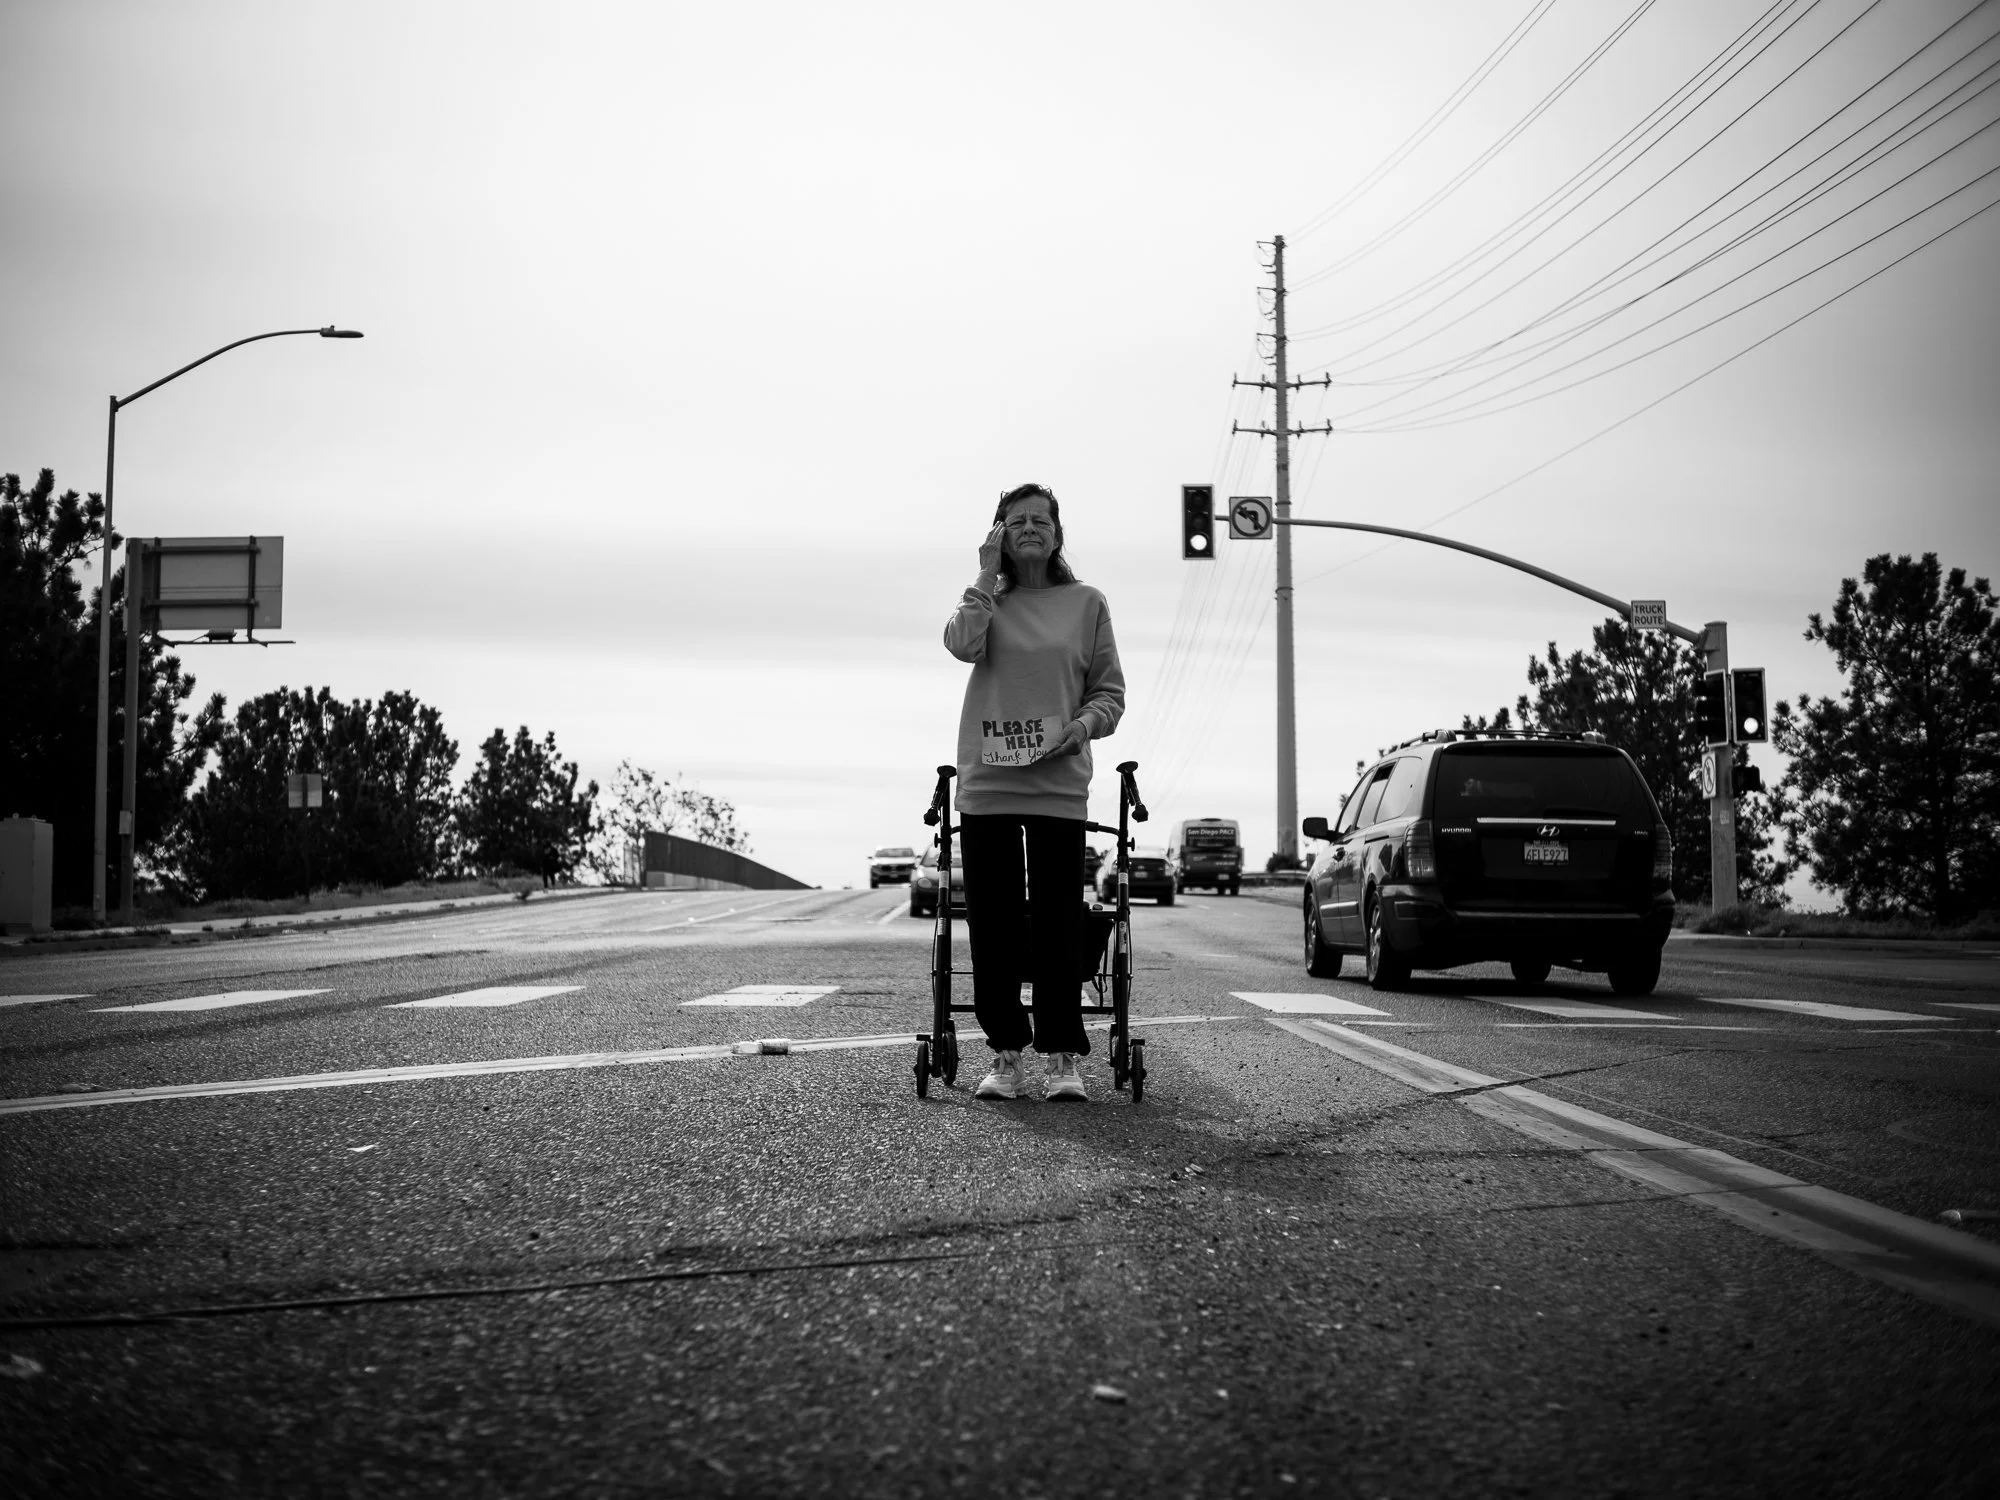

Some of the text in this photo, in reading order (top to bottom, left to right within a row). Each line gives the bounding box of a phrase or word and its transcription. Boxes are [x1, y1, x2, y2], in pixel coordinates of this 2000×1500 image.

[1634, 605, 1663, 614] TRUCK
[1634, 616, 1663, 625] ROUTE
[1005, 734, 1044, 750] HELP
[984, 748, 1047, 764] Thank You
